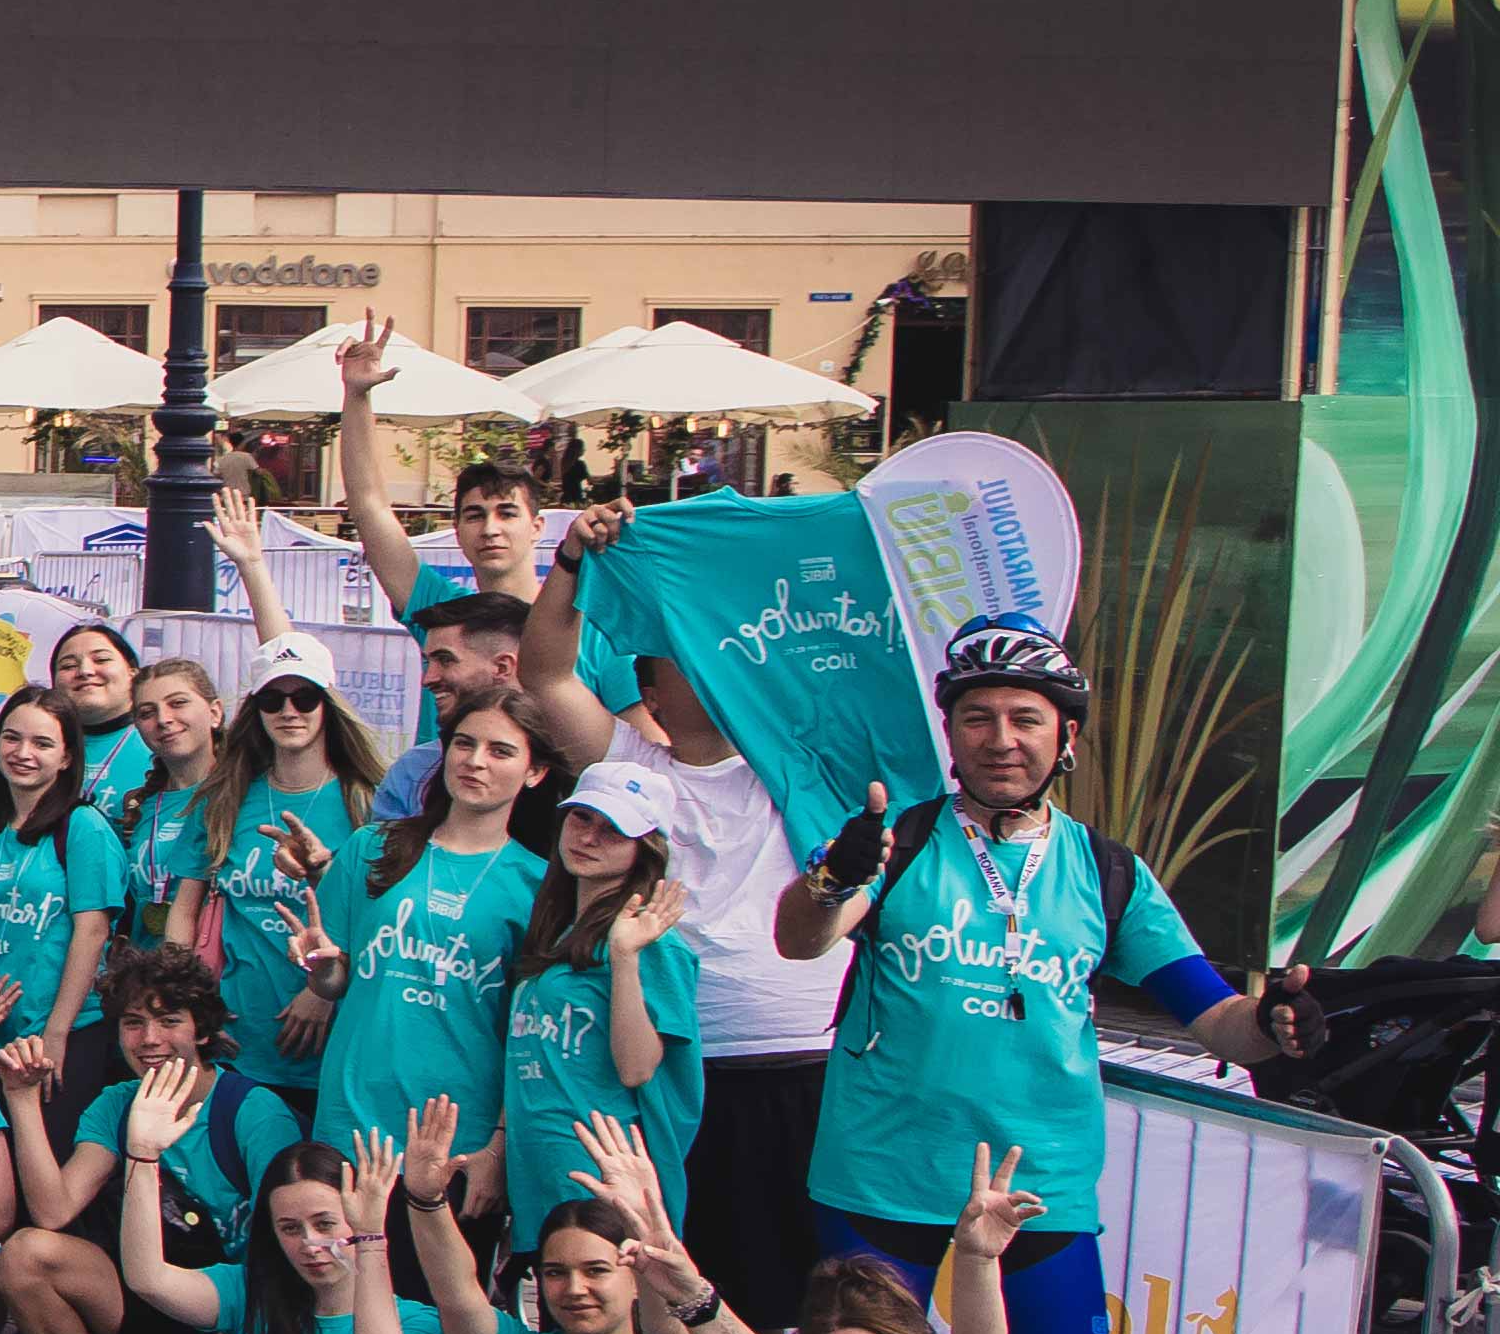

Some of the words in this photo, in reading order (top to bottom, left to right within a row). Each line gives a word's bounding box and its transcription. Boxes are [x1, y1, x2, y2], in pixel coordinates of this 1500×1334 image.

[207, 254, 382, 287] vodafone
[977, 852, 1006, 900] ROMANIA
[428, 900, 464, 921] SIBIU
